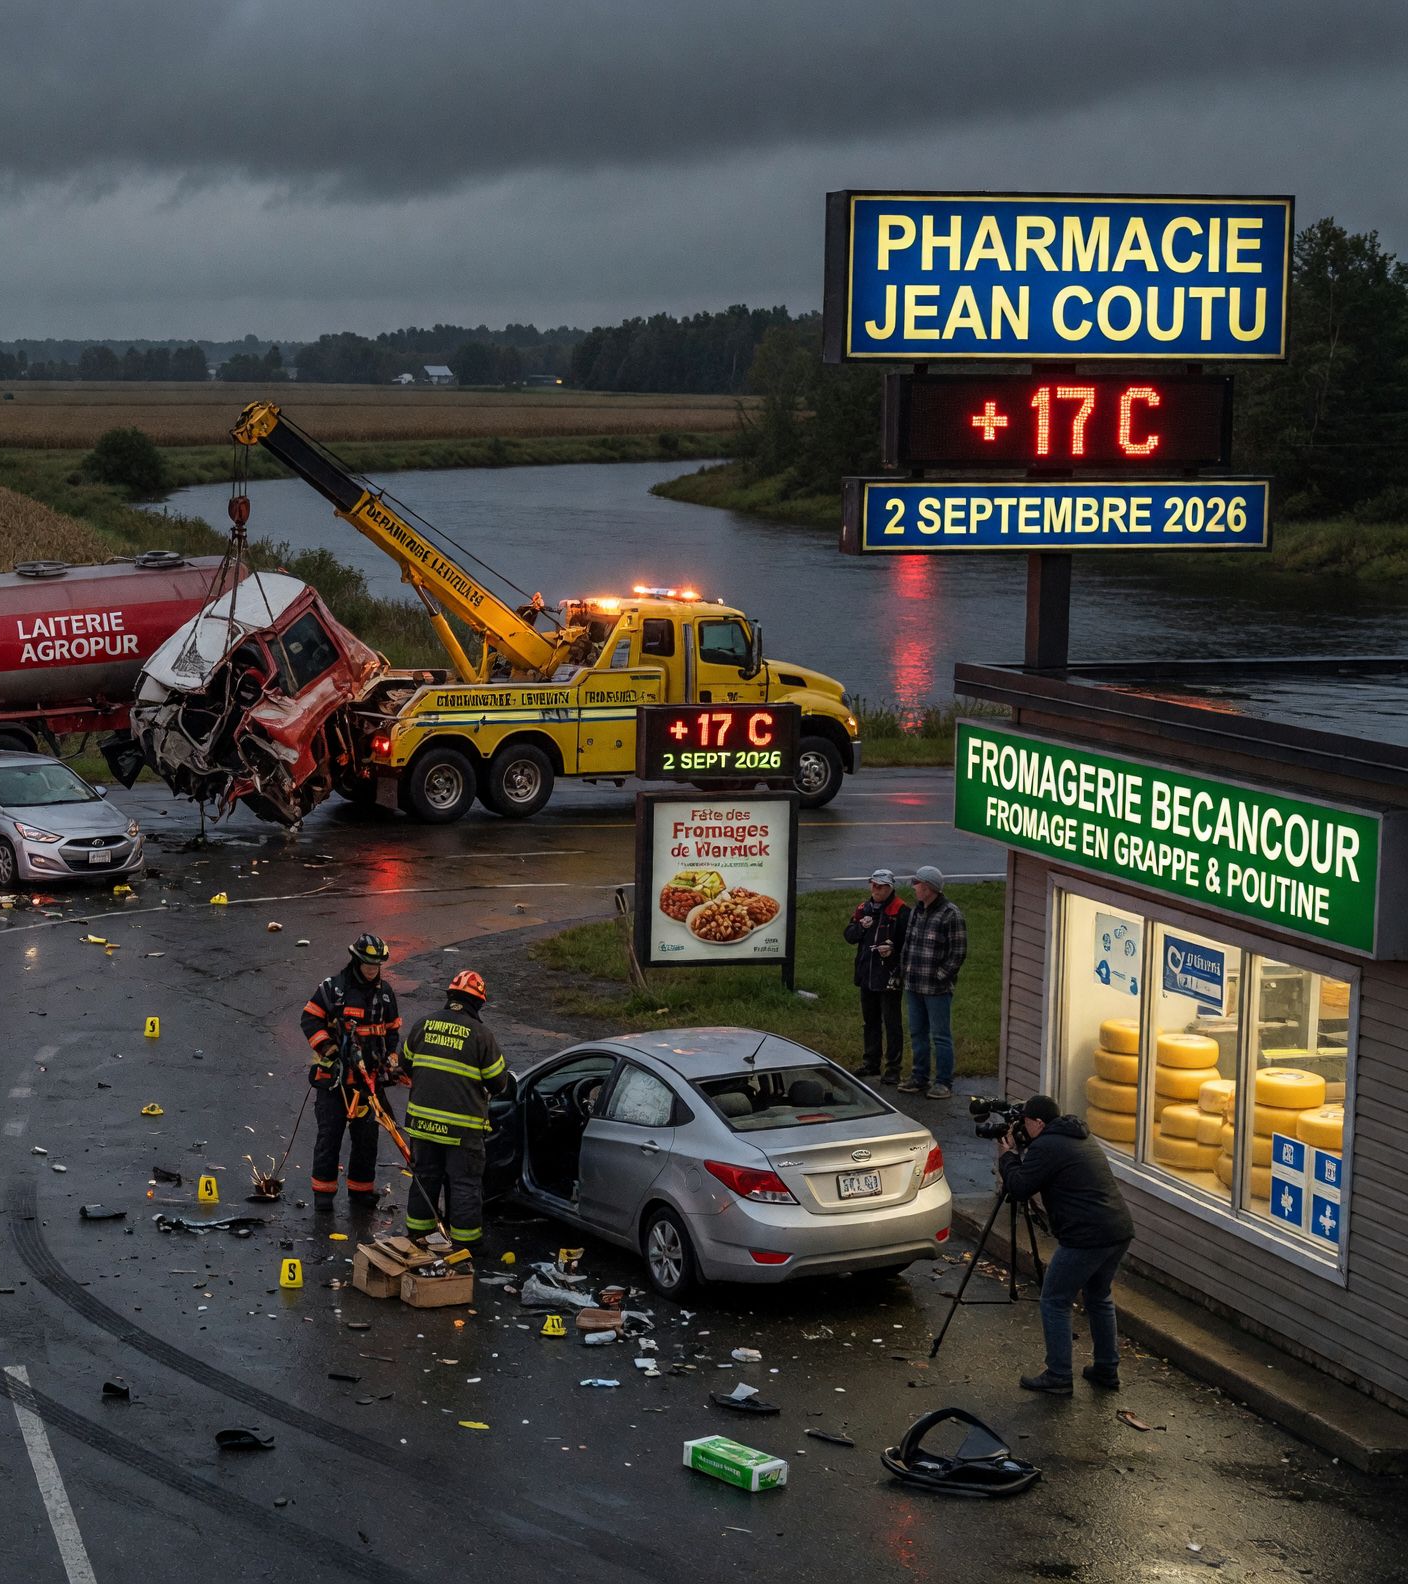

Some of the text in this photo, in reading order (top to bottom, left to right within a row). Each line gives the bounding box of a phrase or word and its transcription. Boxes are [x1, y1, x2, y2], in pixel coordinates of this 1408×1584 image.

[877, 214, 1264, 274] PHARMACIE
[864, 284, 1267, 341] JEAN COUTU
[1119, 386, 1161, 455] C
[883, 496, 1247, 535] 2 SEPTEMBRE 2026
[16, 611, 125, 640] LAITERIE
[20, 634, 140, 663] AGROPUR
[748, 712, 774, 746] C
[662, 751, 781, 770] 2 SEPT 2026
[726, 808, 751, 821] des
[967, 736, 1361, 883] FROMAGERIE BECANCOUR
[672, 822, 769, 842] Fromages
[671, 842, 690, 857] de
[986, 796, 1330, 926] FROMAGE EN GRAPPE & POUTINE
